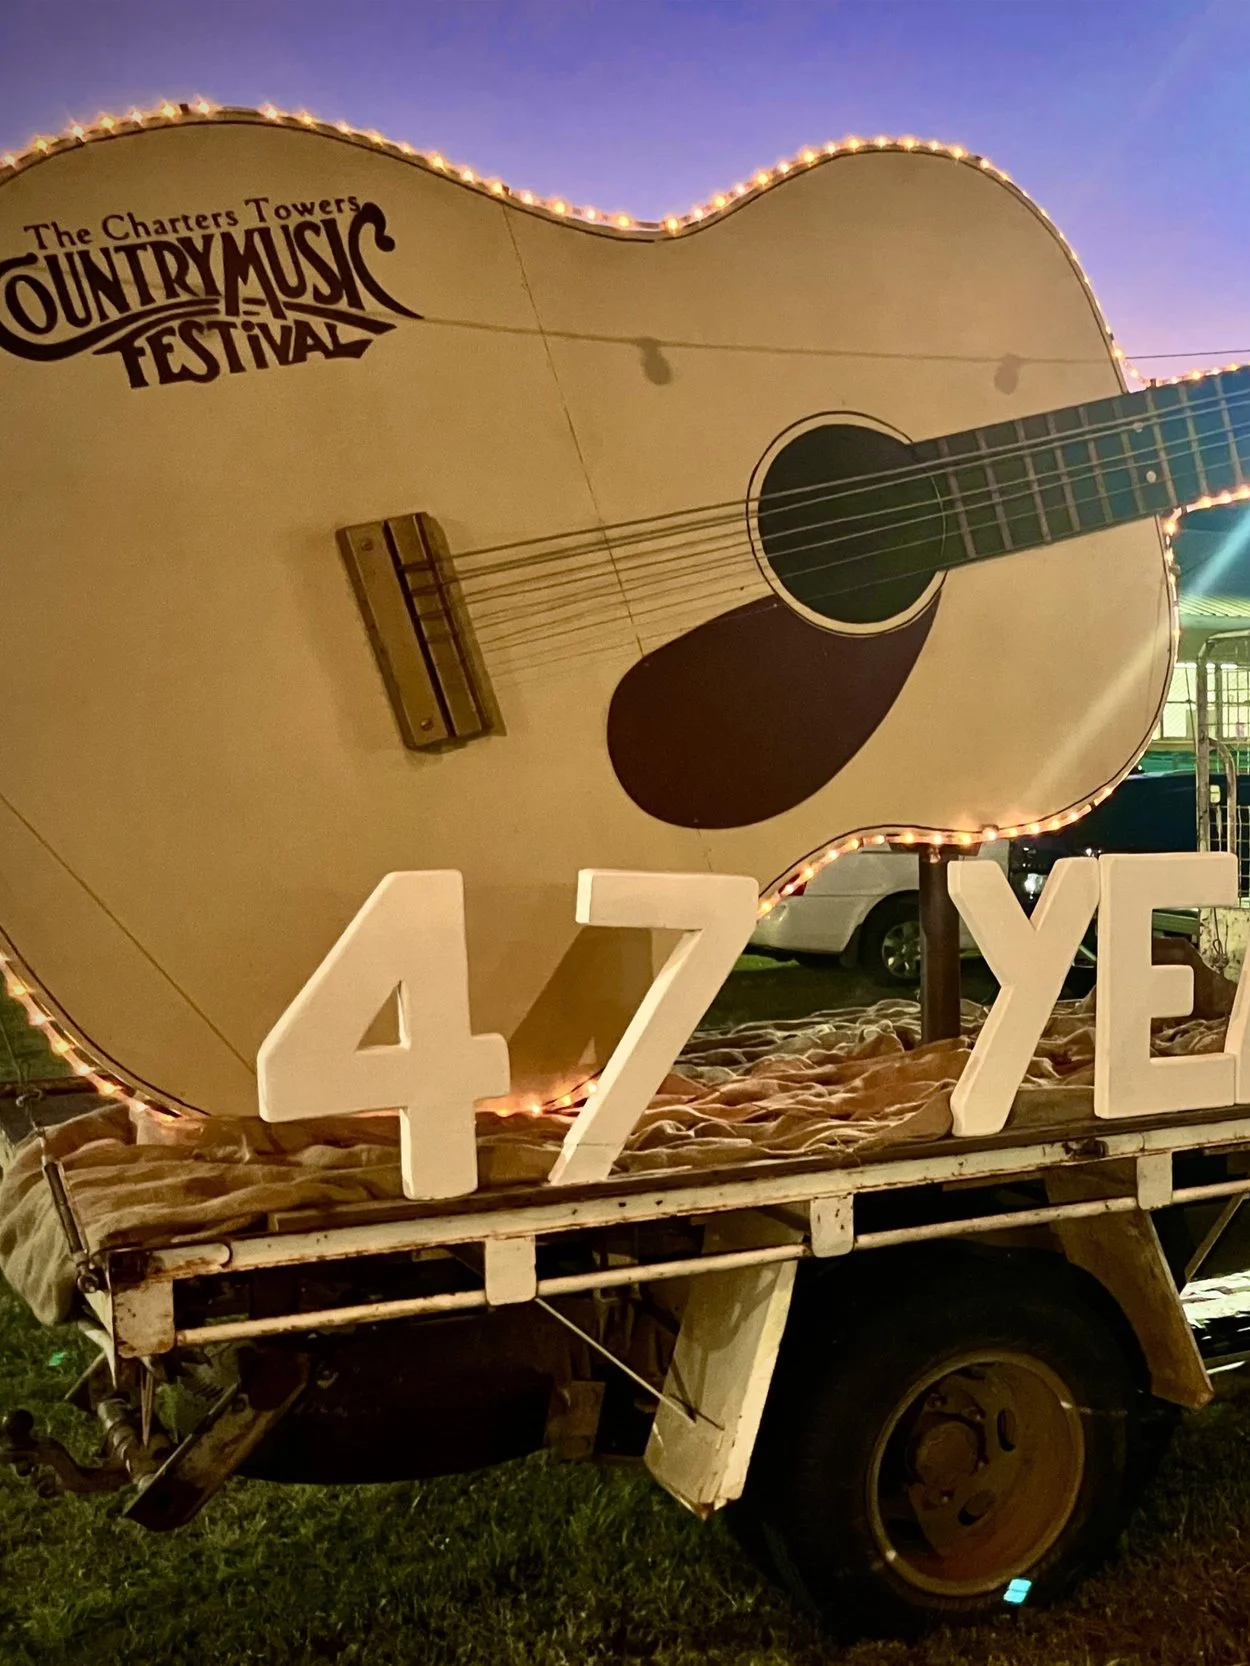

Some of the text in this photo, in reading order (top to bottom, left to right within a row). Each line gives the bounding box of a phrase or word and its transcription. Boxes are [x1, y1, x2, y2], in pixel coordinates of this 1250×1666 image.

[23, 195, 361, 251] The Charters Towers
[220, 201, 425, 320] MUSIC
[256, 868, 760, 1201] 47
